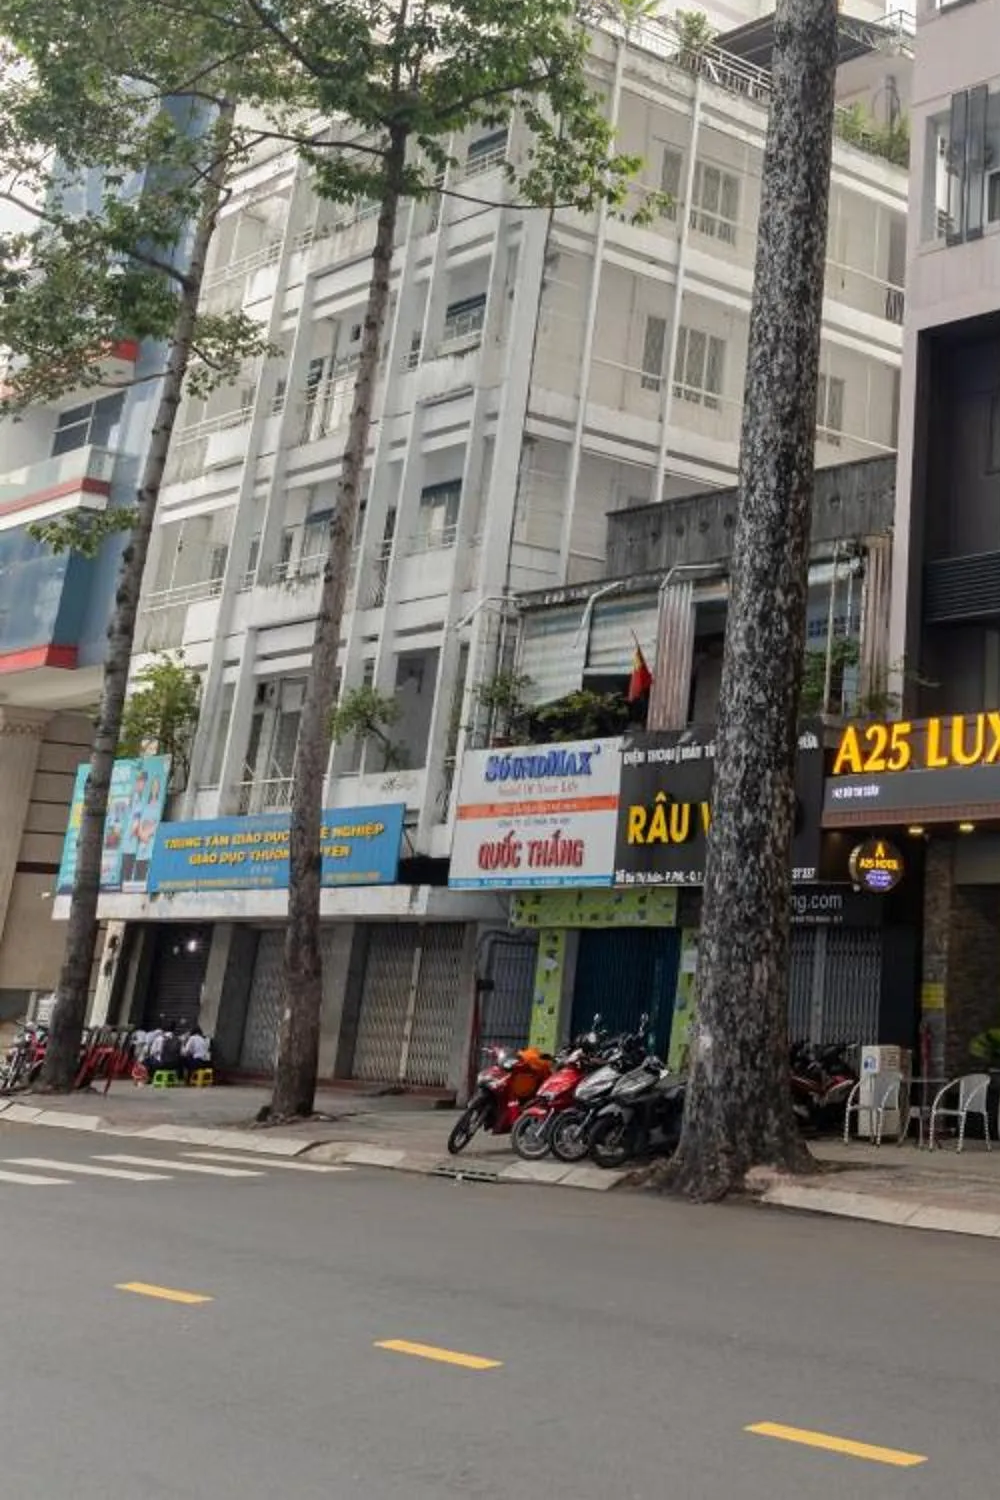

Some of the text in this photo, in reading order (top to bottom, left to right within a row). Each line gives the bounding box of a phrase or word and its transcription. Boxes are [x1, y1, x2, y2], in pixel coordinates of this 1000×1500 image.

[832, 720, 912, 774] A25
[627, 790, 691, 844] RÂU
[478, 829, 584, 869] QUỐC THẮNG
